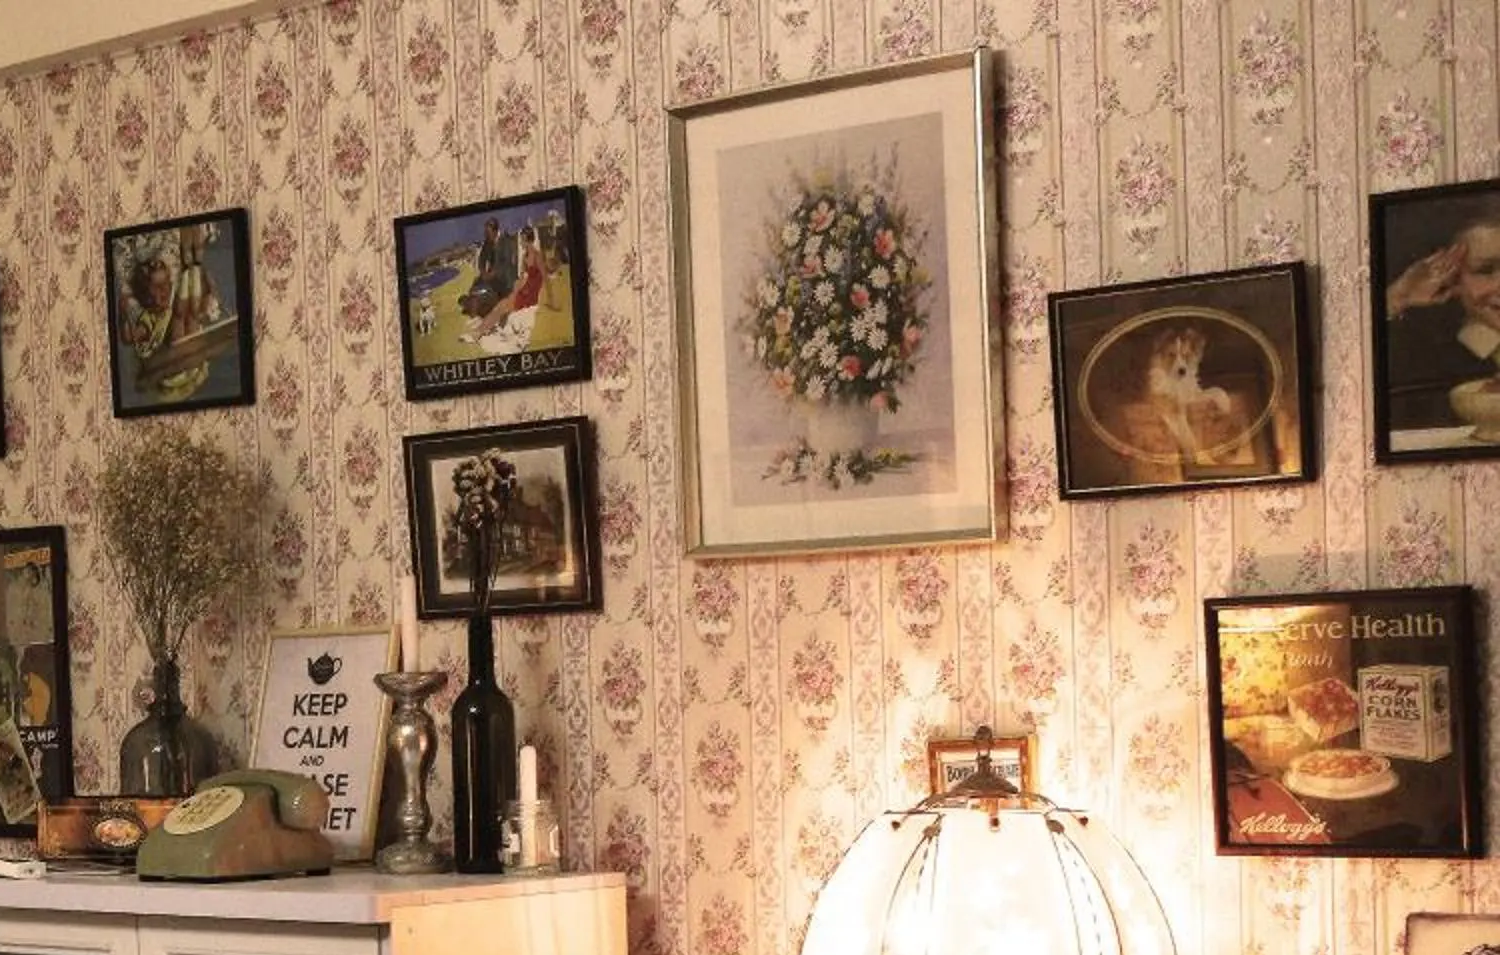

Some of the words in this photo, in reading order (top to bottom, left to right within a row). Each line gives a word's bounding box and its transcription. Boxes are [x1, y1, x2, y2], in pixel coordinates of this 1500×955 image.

[424, 357, 511, 382] WHITLEY
[521, 350, 564, 371] BAY
[1351, 613, 1446, 640] Health
[293, 694, 348, 716] KEEP
[1366, 705, 1421, 720] FLAKES
[1368, 695, 1418, 709] CORN
[283, 726, 349, 749] CALM
[300, 755, 324, 766] AND
[323, 773, 349, 796] SE
